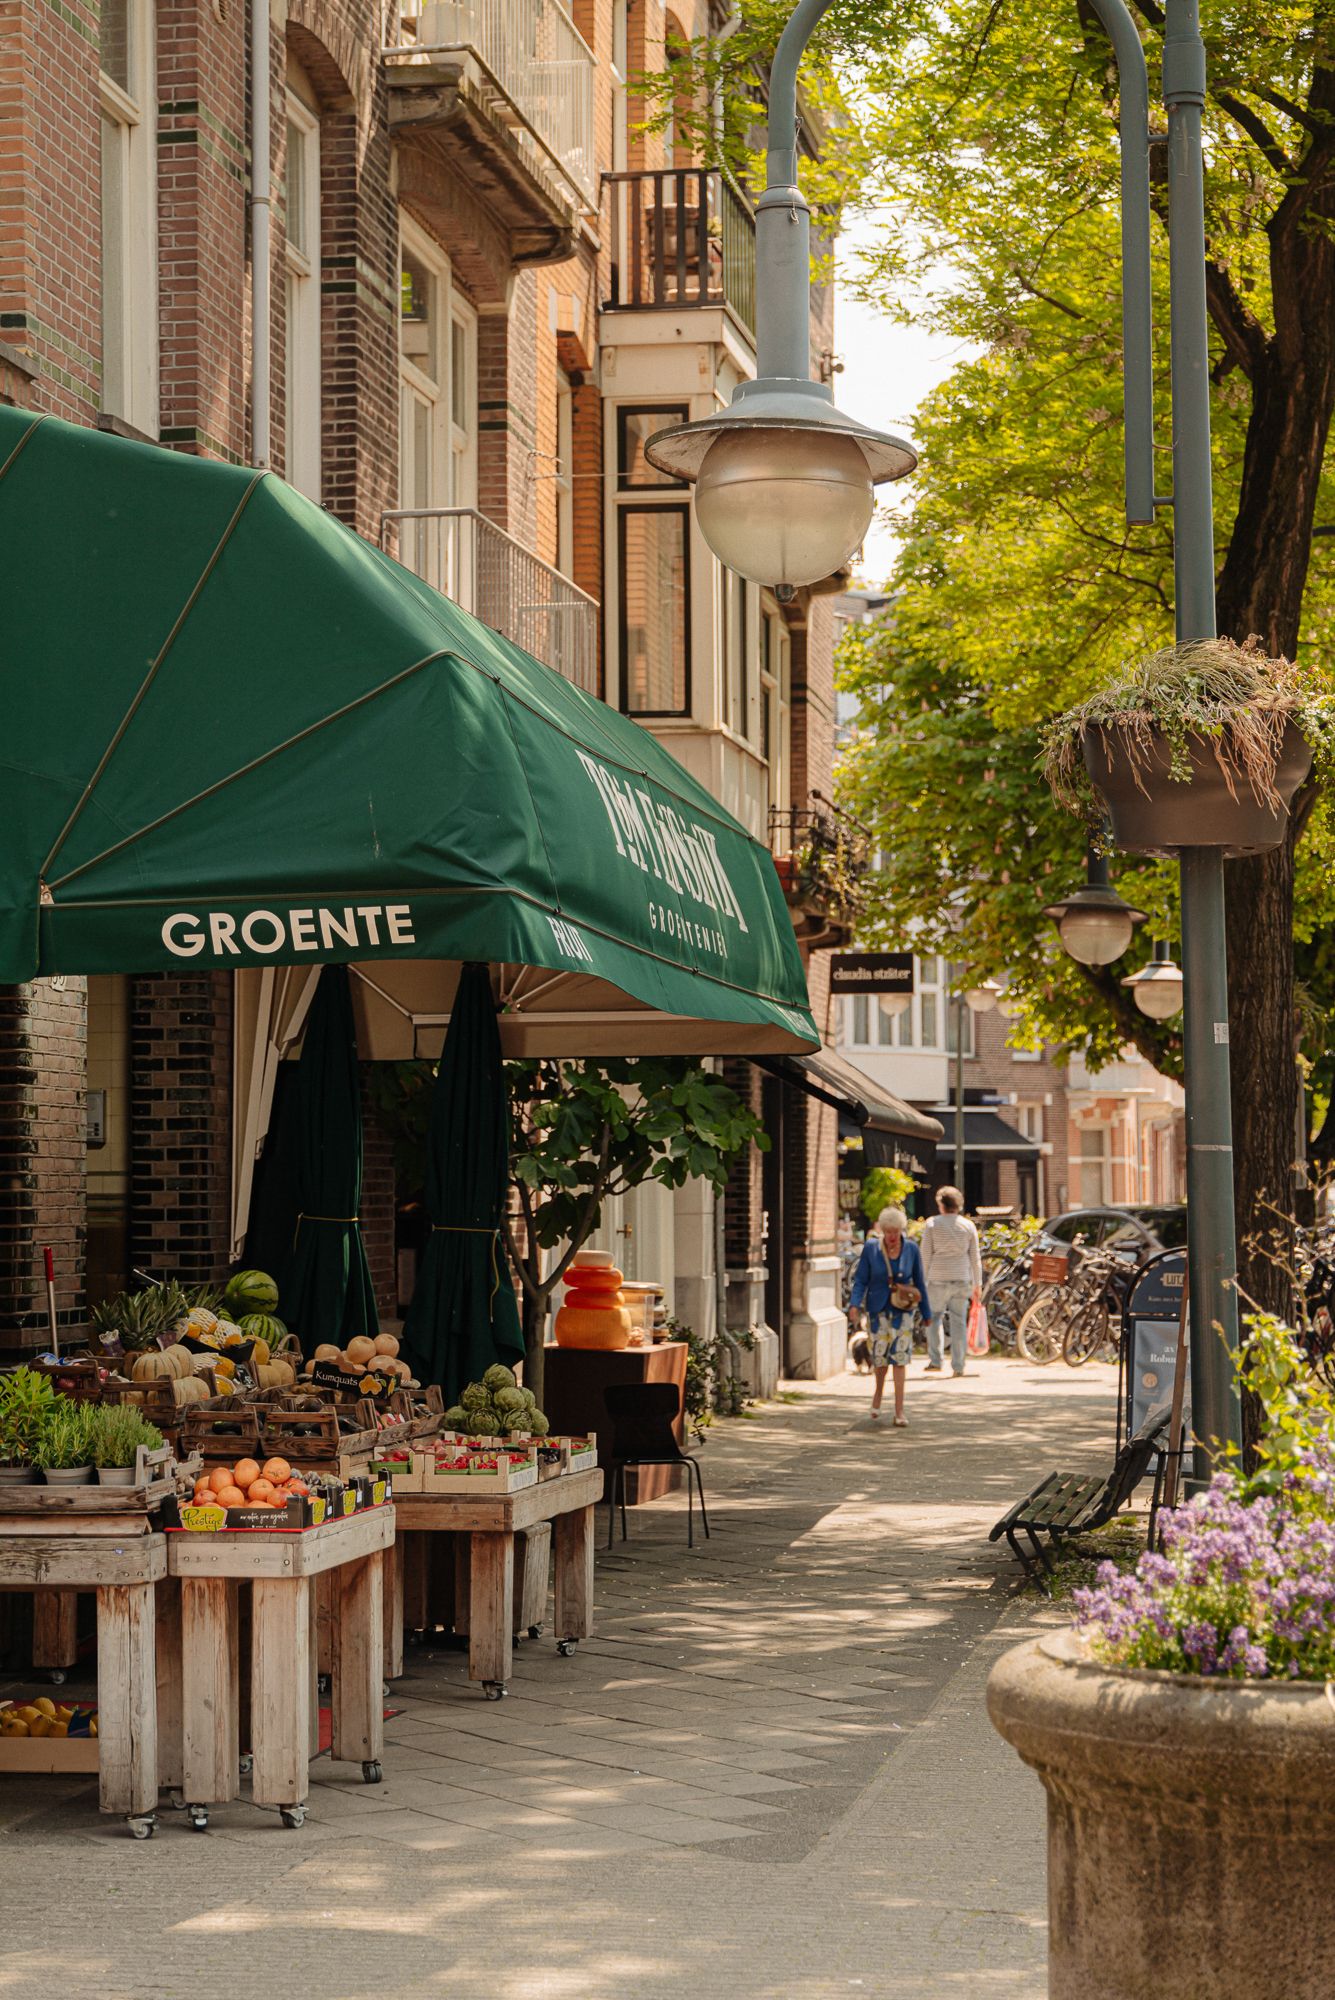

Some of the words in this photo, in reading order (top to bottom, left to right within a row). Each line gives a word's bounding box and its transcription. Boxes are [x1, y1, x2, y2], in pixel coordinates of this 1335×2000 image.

[161, 904, 416, 957] GROENTE
[545, 915, 593, 963] FRUIT
[832, 966, 873, 981] claudia
[315, 1370, 358, 1388] Kumquats
[181, 1508, 222, 1531] Prestige
